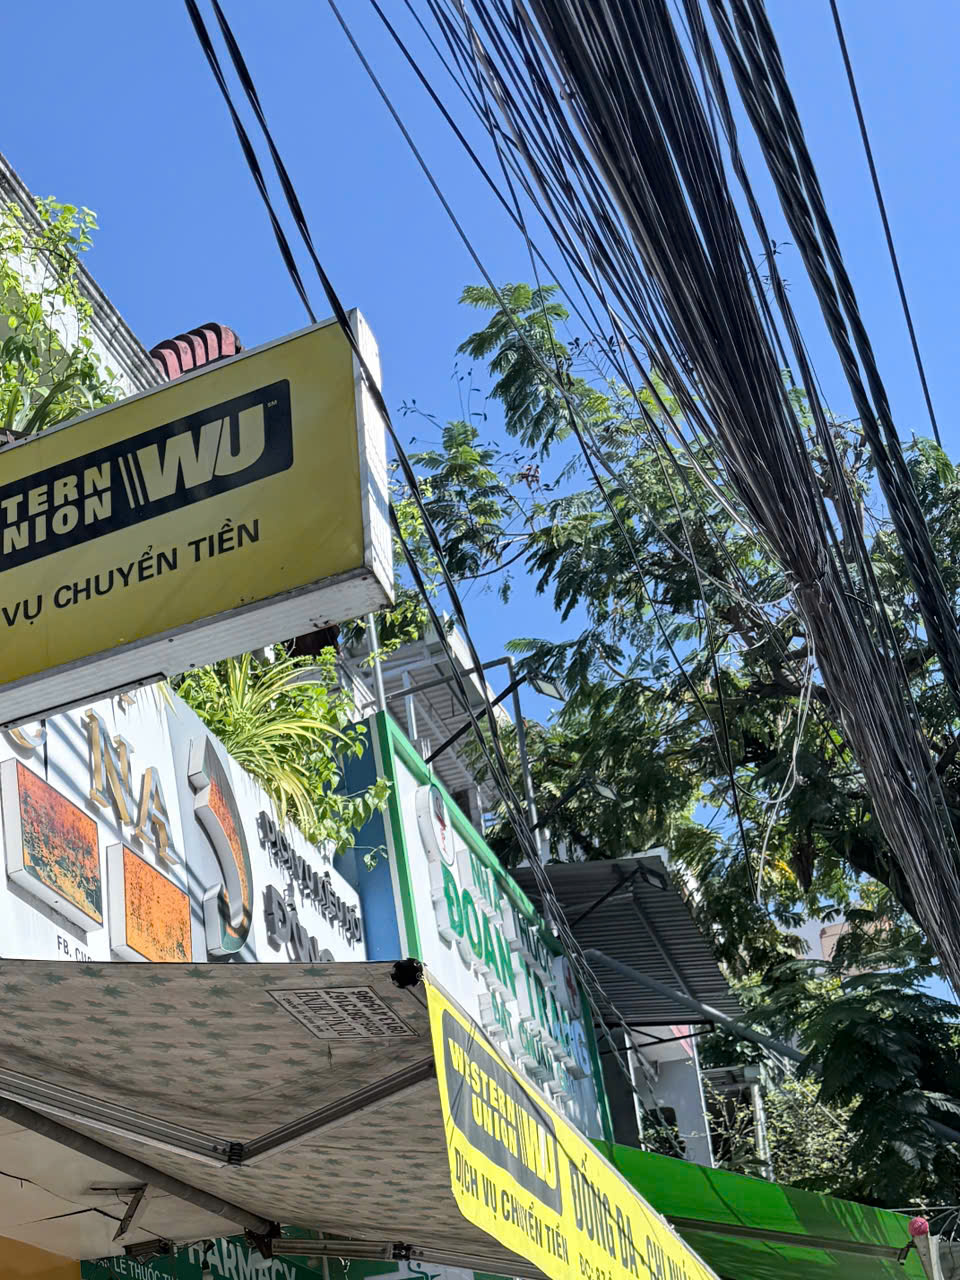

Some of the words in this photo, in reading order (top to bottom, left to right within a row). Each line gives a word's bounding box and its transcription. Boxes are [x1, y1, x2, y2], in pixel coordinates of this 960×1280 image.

[138, 403, 265, 502] WU
[2, 594, 42, 626] VỤ
[53, 545, 178, 610] CHUYỂN
[188, 517, 260, 563] TIỀN
[448, 1037, 516, 1127] WESTERN
[521, 1108, 557, 1190] WU
[471, 1092, 518, 1160] UNION
[454, 1146, 479, 1200] DỊCH
[481, 1173, 498, 1221] VỤ
[501, 1188, 543, 1249] CHUYỂN
